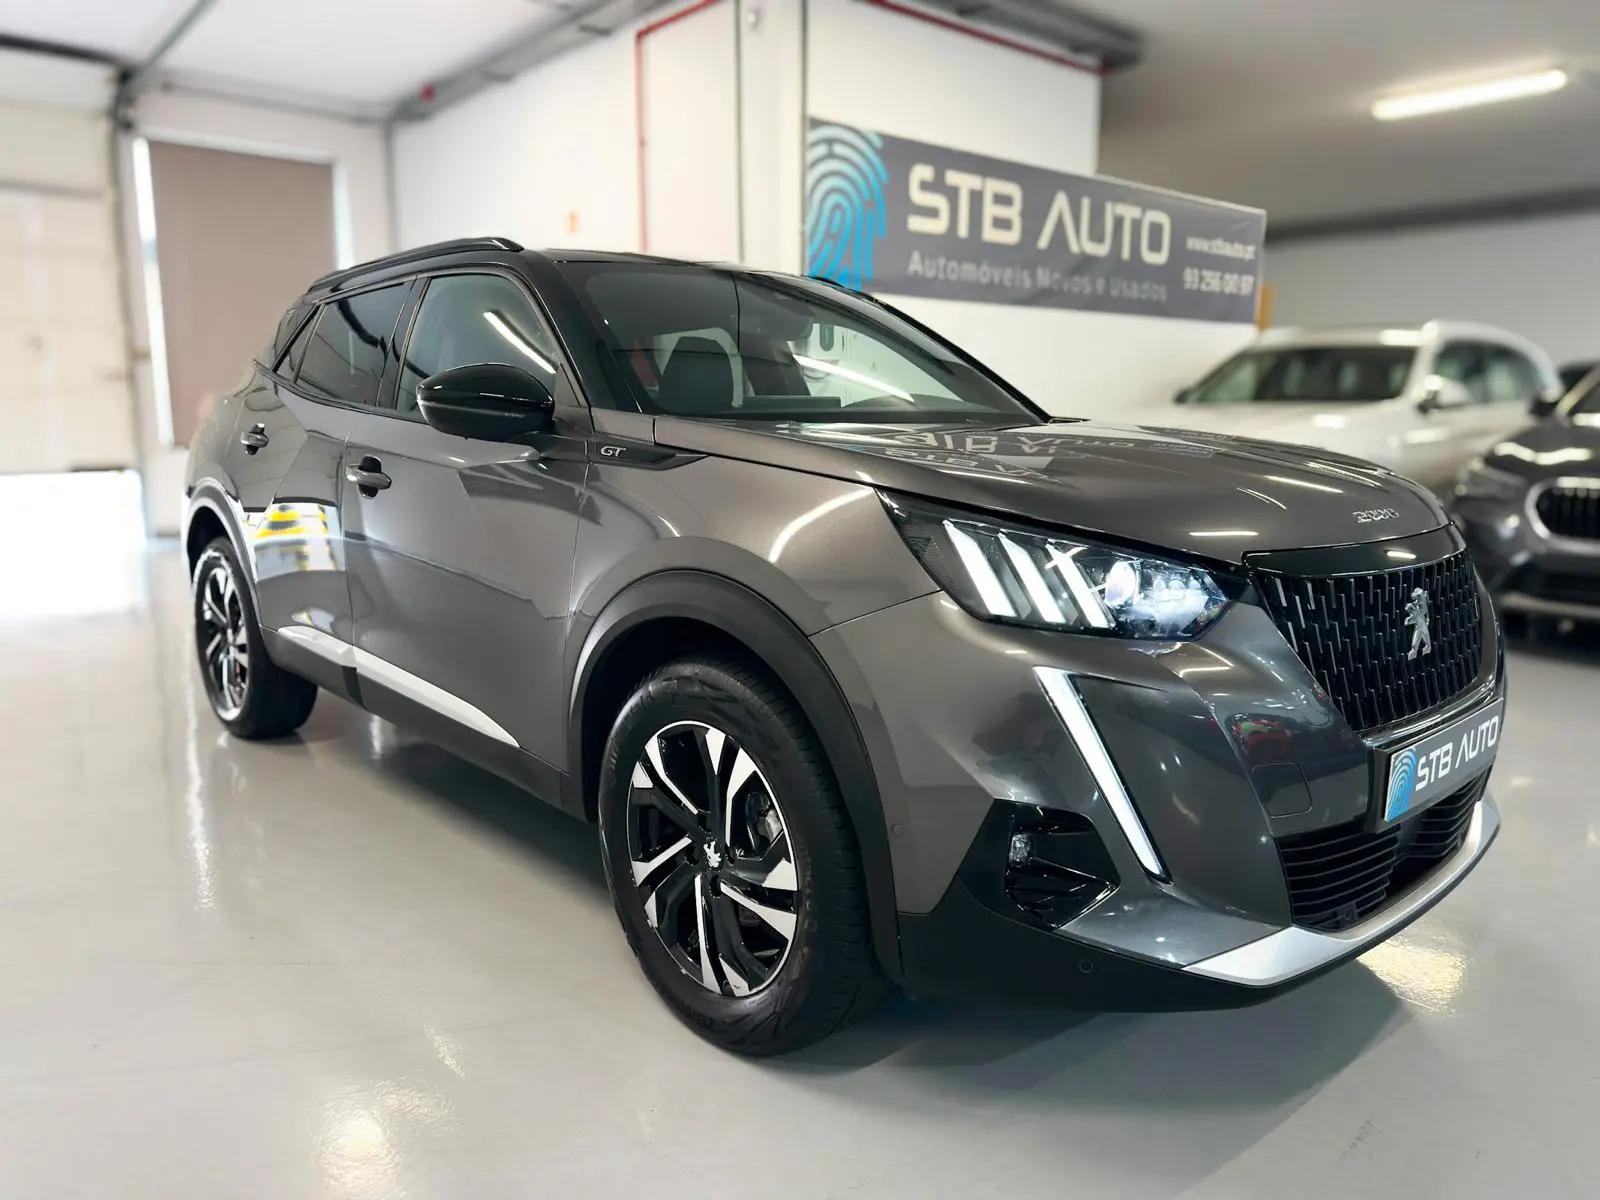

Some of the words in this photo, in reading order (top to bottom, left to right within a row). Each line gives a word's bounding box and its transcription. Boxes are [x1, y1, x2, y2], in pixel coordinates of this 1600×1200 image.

[907, 163, 1022, 246] STB
[1036, 190, 1171, 265] AUTO
[907, 250, 1031, 289] Automóveis
[601, 445, 627, 457] GT
[1416, 742, 1453, 791] STB
[1455, 715, 1499, 768] AUTO
